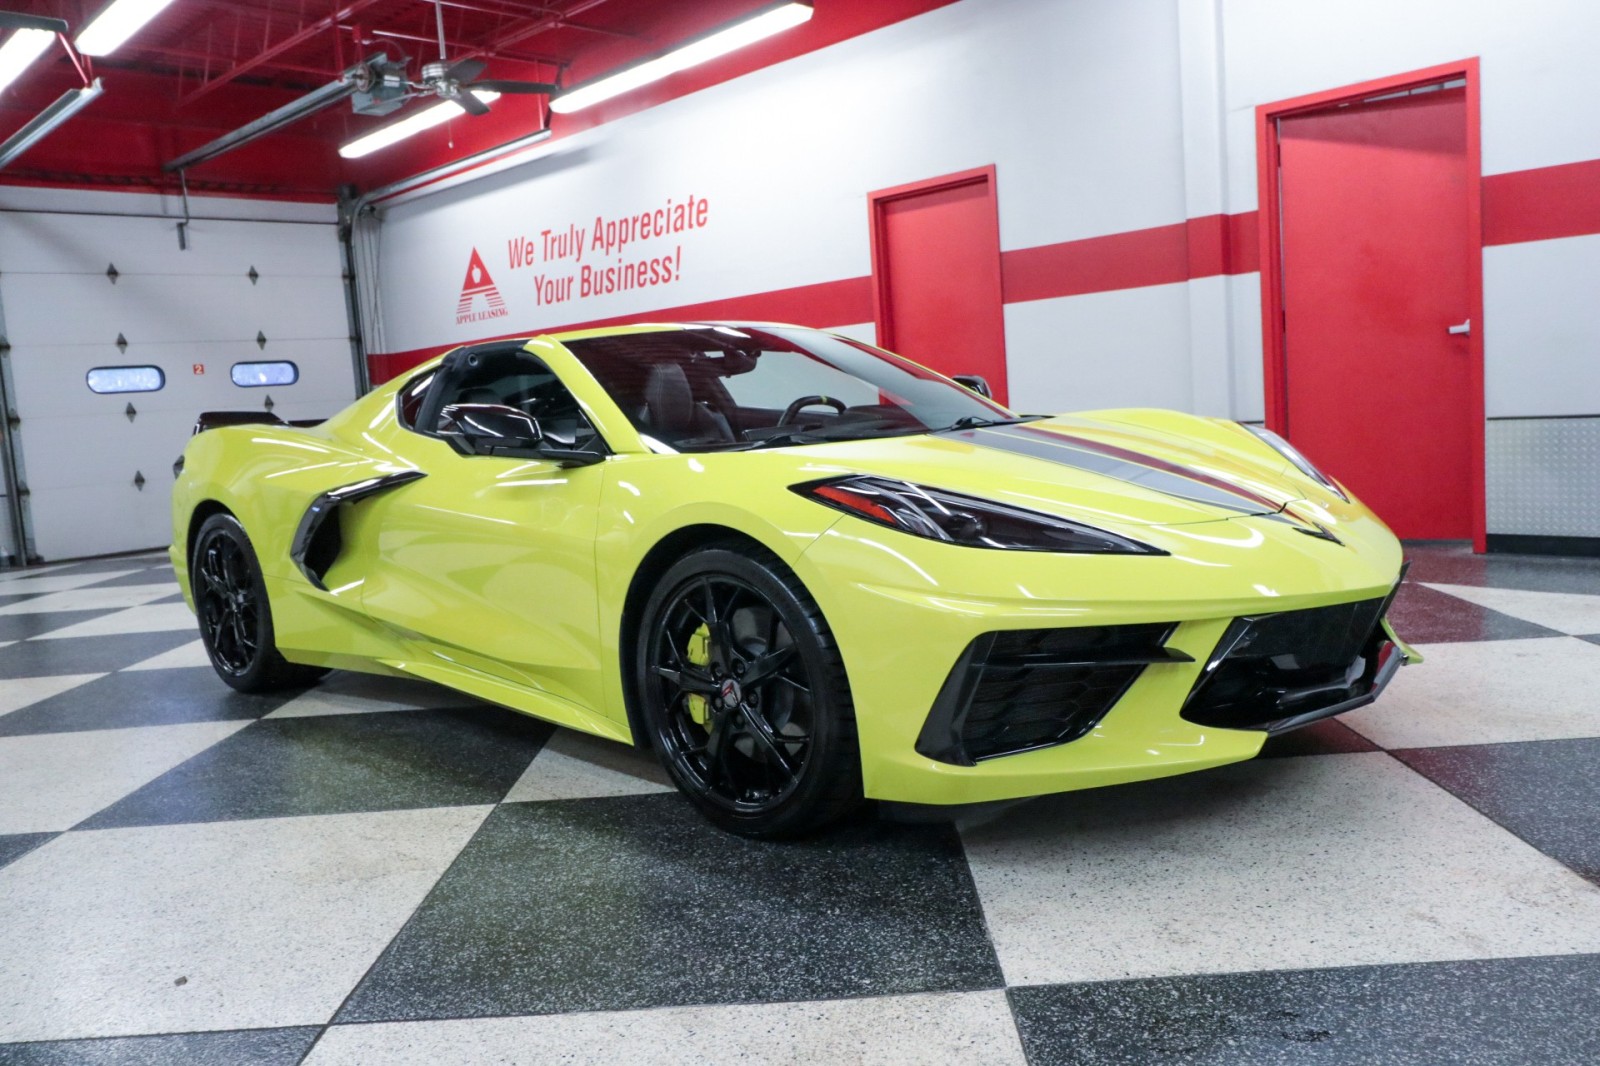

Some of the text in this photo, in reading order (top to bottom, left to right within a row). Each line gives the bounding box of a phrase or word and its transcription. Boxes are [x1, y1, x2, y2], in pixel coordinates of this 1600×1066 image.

[508, 194, 709, 270] We Truly Appreciate
[534, 245, 682, 307] Your Business!
[456, 308, 509, 325] APPLE LEASING
